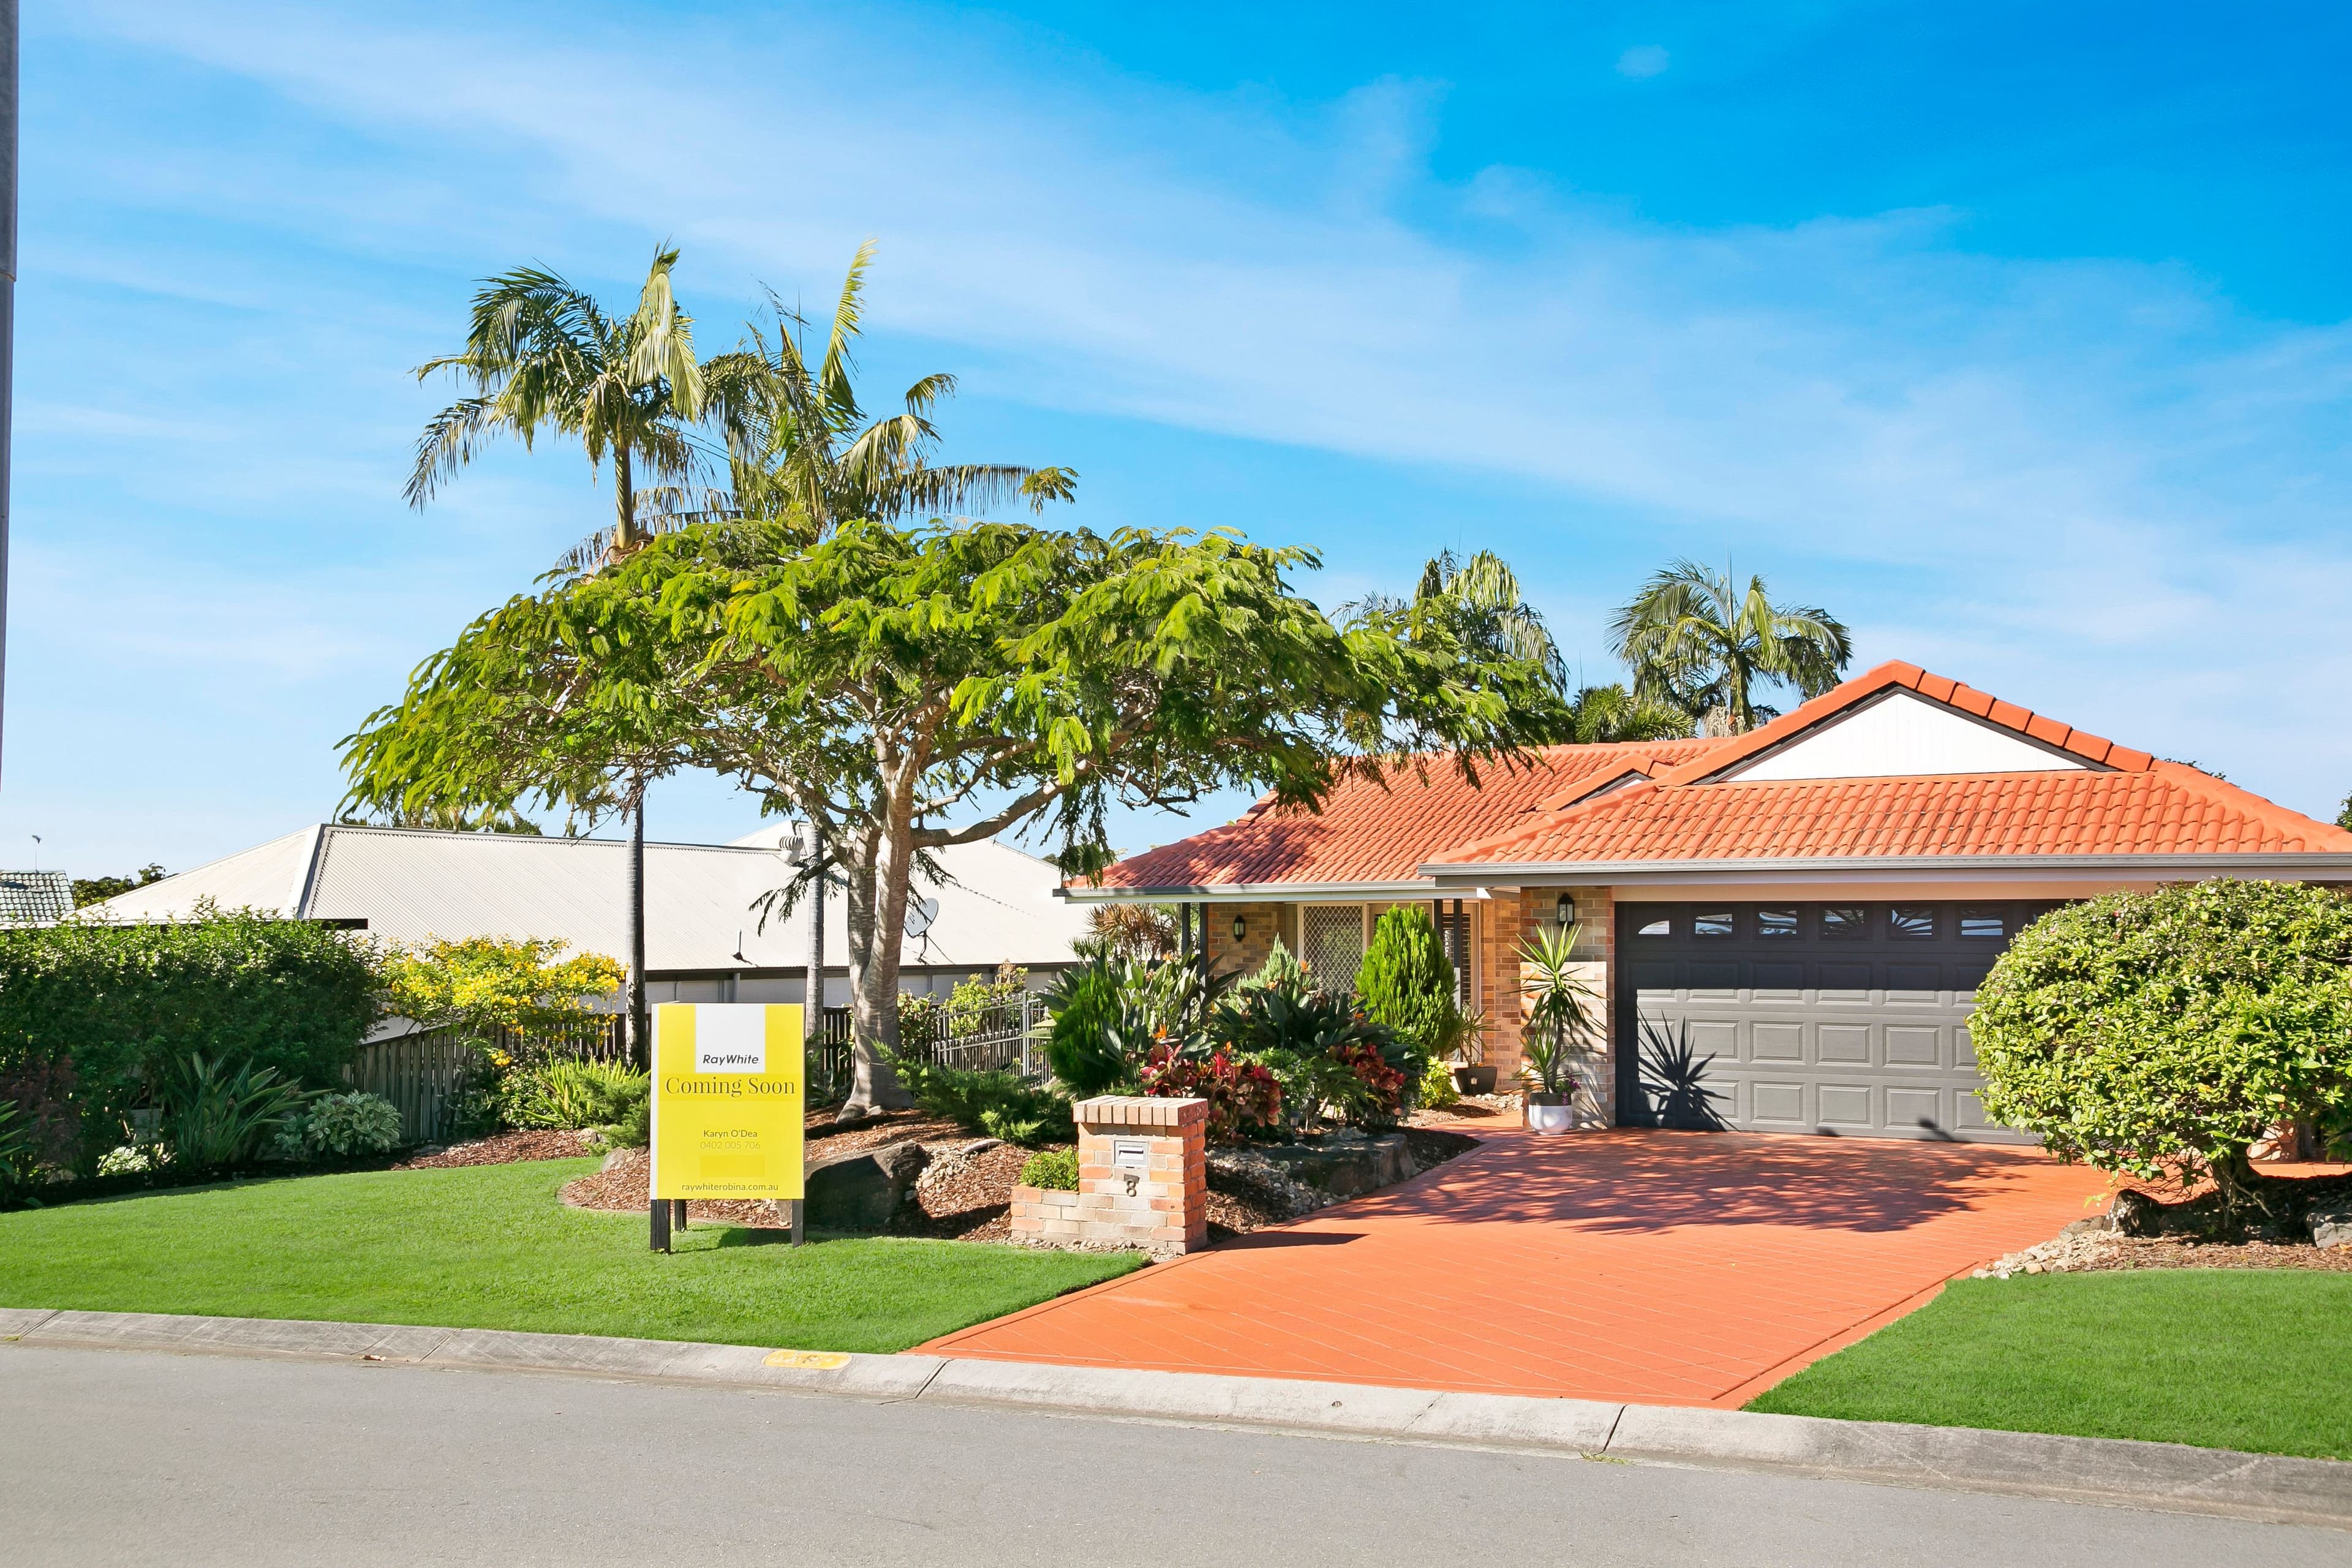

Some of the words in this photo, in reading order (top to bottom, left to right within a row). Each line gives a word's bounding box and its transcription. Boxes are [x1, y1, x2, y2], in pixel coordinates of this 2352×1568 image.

[666, 1076, 742, 1098] Coming
[748, 1077, 795, 1094] Soon
[703, 1129, 728, 1139] Karyn
[681, 1183, 778, 1193] raywhiterobina.com.au
[1126, 1180, 1137, 1197] 8
